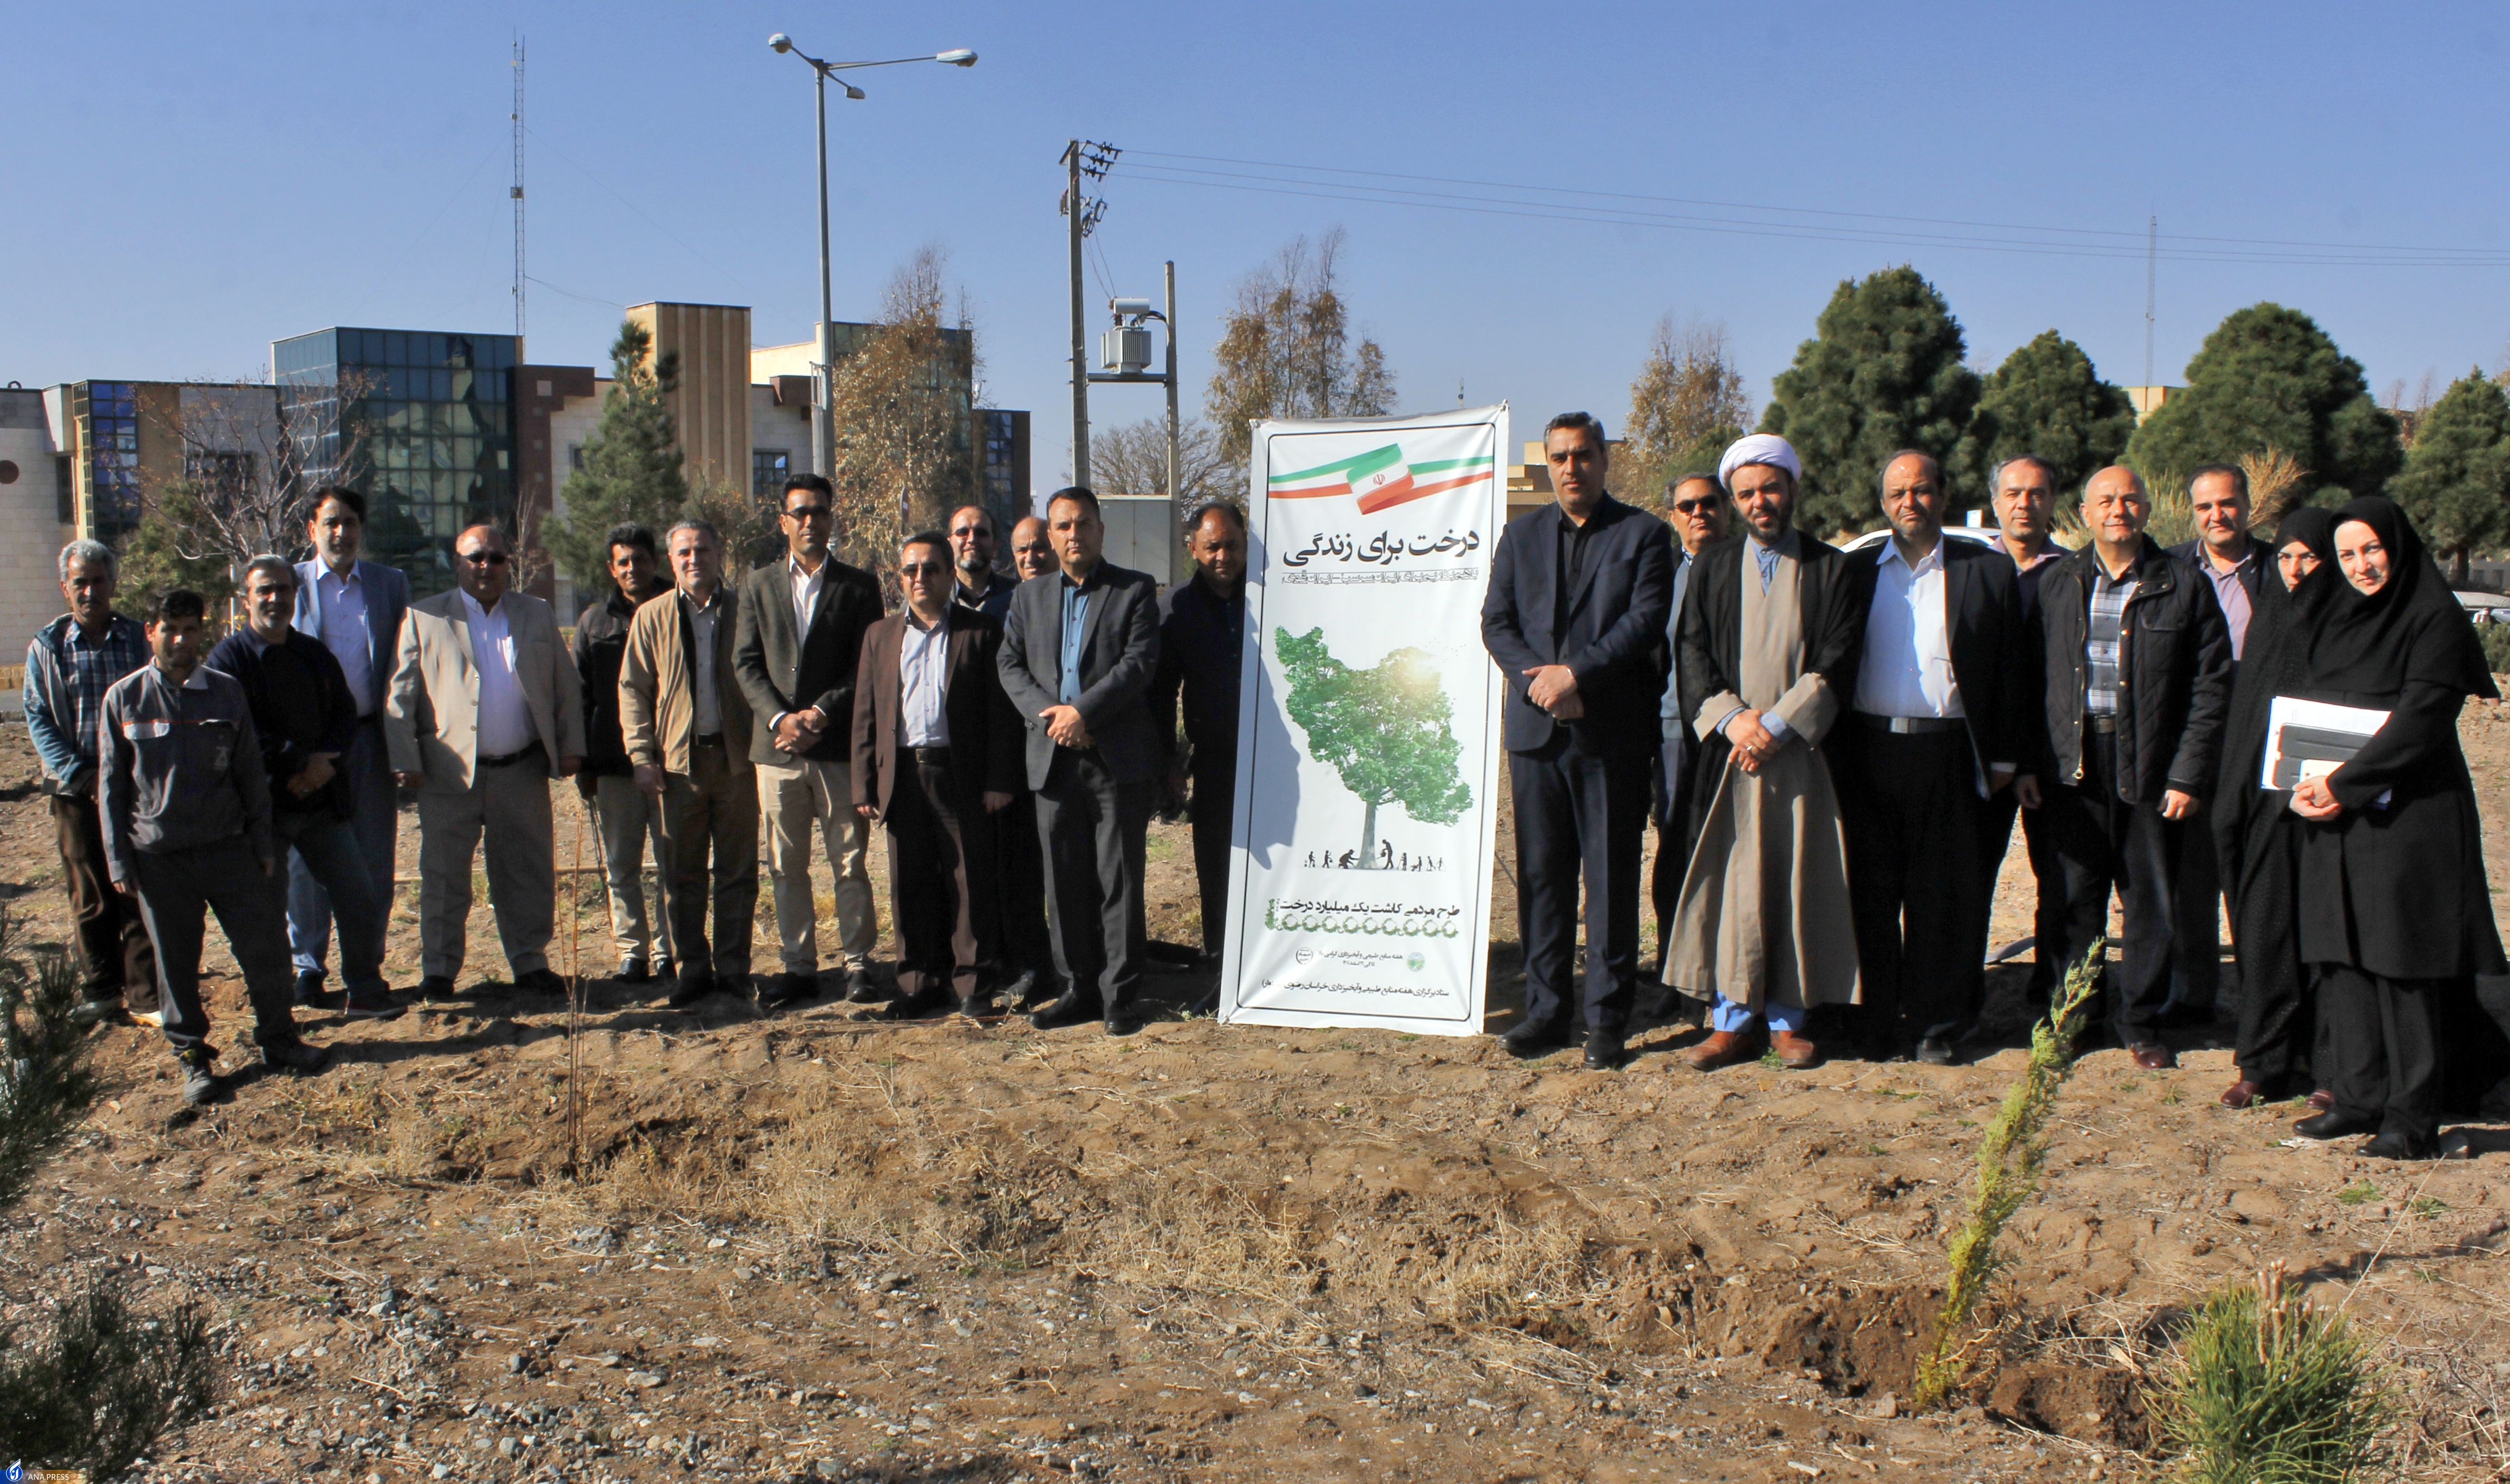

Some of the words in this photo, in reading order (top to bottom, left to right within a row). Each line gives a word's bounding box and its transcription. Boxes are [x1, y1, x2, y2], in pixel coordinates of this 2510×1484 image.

[1283, 533, 1352, 567] زندگی
[1357, 530, 1404, 565] برای
[1409, 529, 1480, 557] درخت
[1280, 899, 1314, 913] درخت
[1315, 900, 1349, 914] میلیارد
[1350, 901, 1369, 916] یک
[1371, 902, 1403, 913] کاشت
[1404, 904, 1435, 918] مردمی
[1436, 904, 1460, 919] طرح
[1284, 981, 1305, 990] رضوی
[1305, 981, 1328, 991] خراسان
[1381, 986, 1398, 996] منابع
